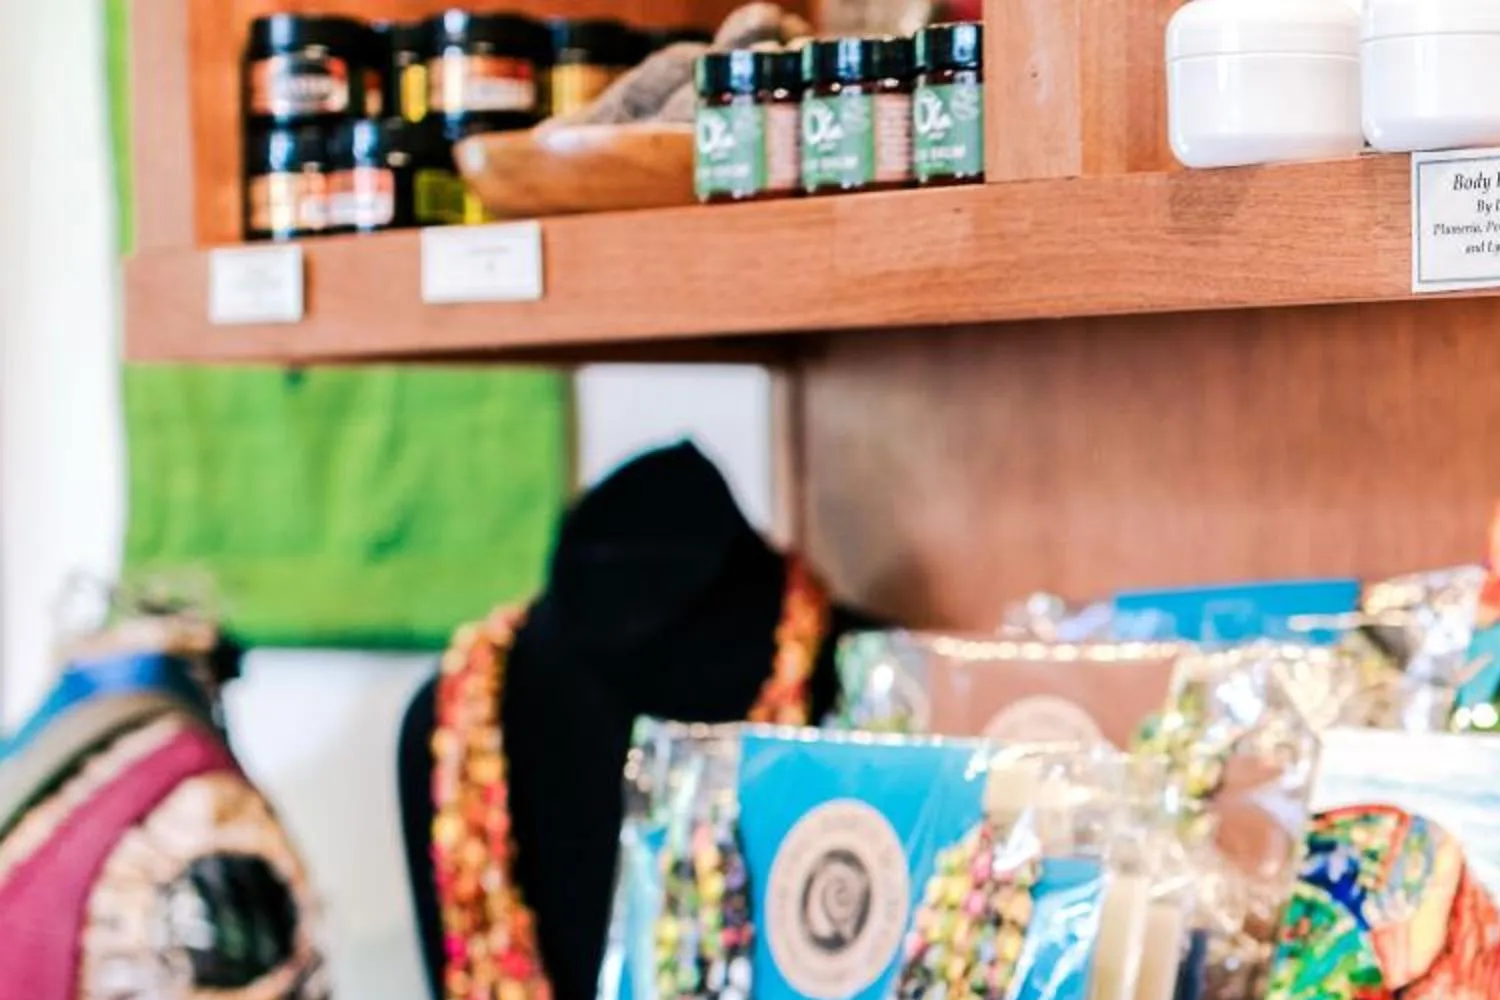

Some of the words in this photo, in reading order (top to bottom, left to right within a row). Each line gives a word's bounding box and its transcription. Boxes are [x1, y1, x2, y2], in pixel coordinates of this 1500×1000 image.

[1453, 171, 1491, 193] Body
[1477, 199, 1493, 216] By
[1465, 240, 1485, 253] and
